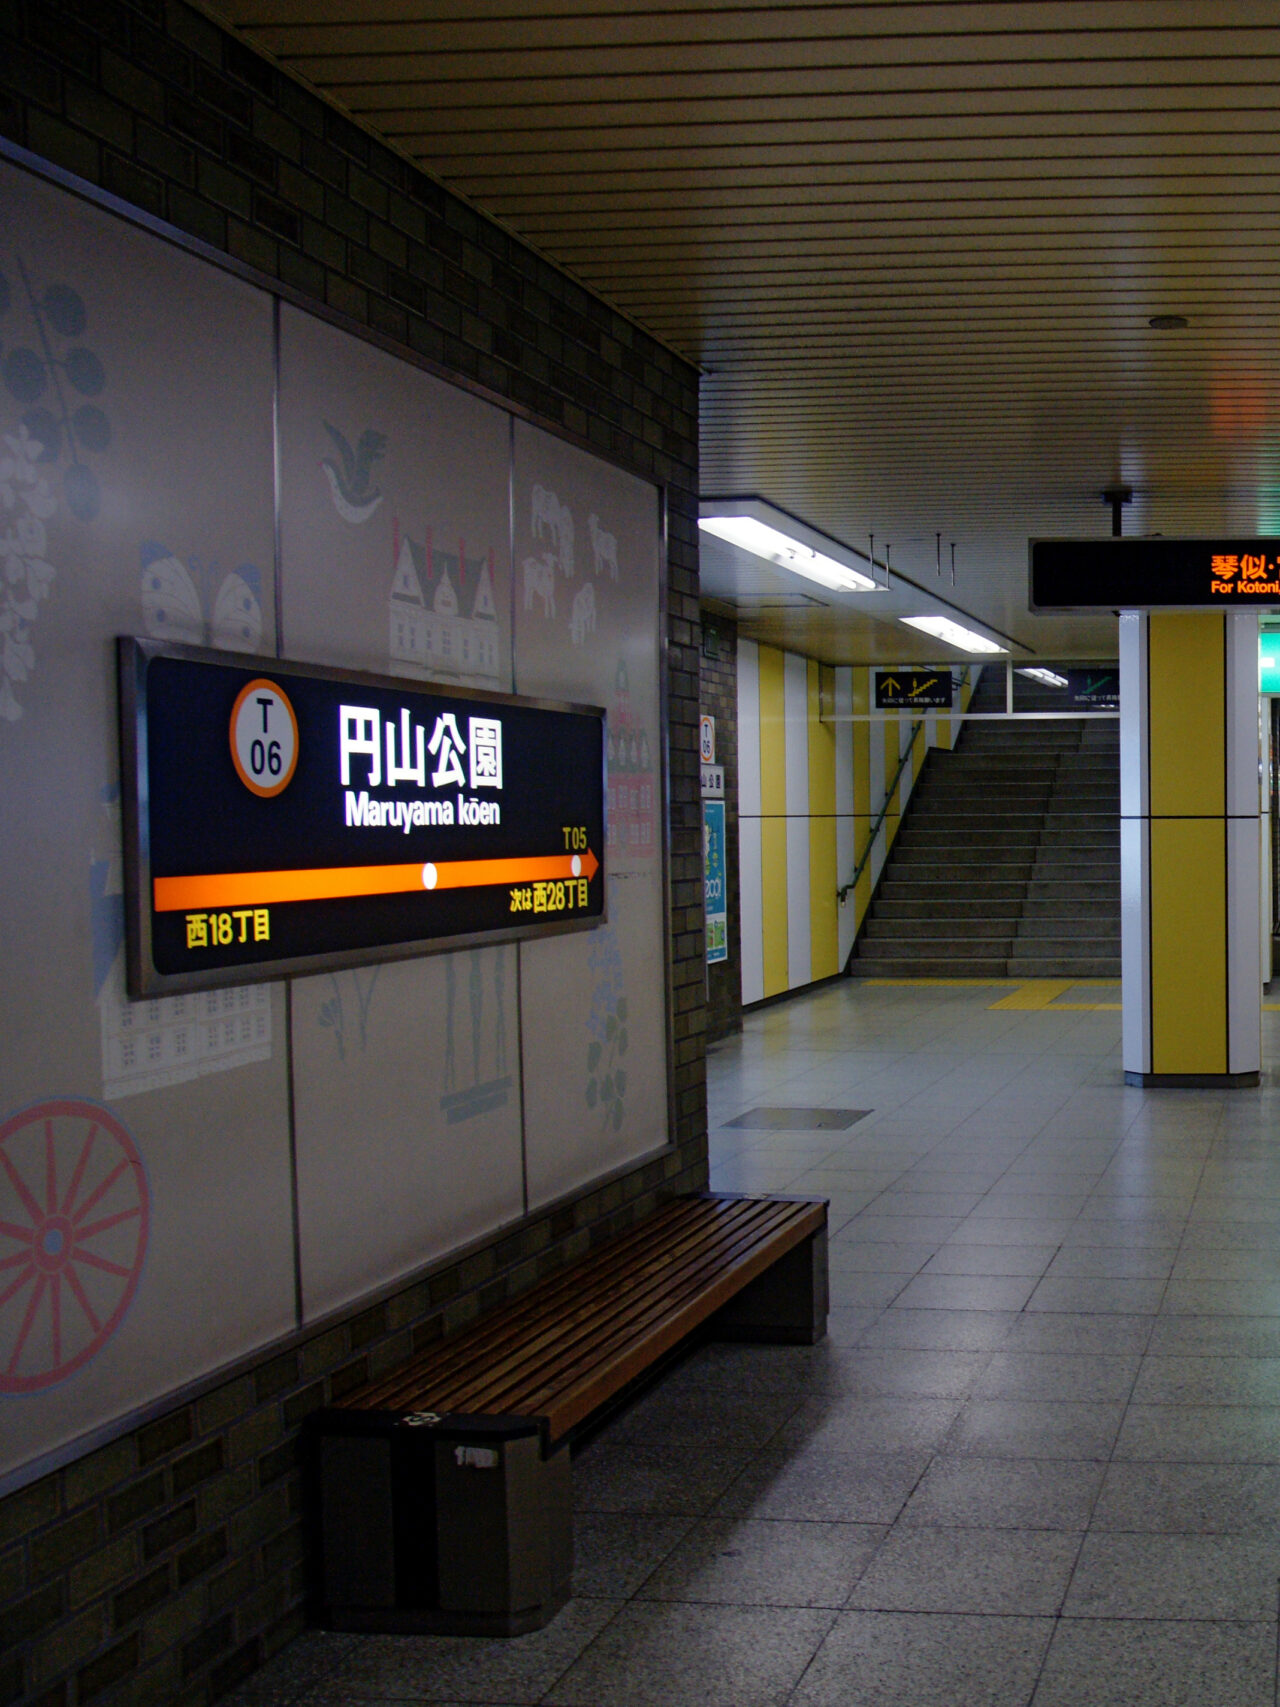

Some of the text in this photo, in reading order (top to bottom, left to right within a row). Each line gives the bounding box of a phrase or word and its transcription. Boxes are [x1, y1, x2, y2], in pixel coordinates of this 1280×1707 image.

[1211, 581, 1234, 593] For
[256, 699, 274, 733] T
[250, 739, 282, 775] 06
[339, 705, 503, 789] 円山公園
[701, 773, 721, 788] 山公園
[345, 790, 500, 834] Maruyama kōen
[186, 909, 270, 948] 西18丁目
